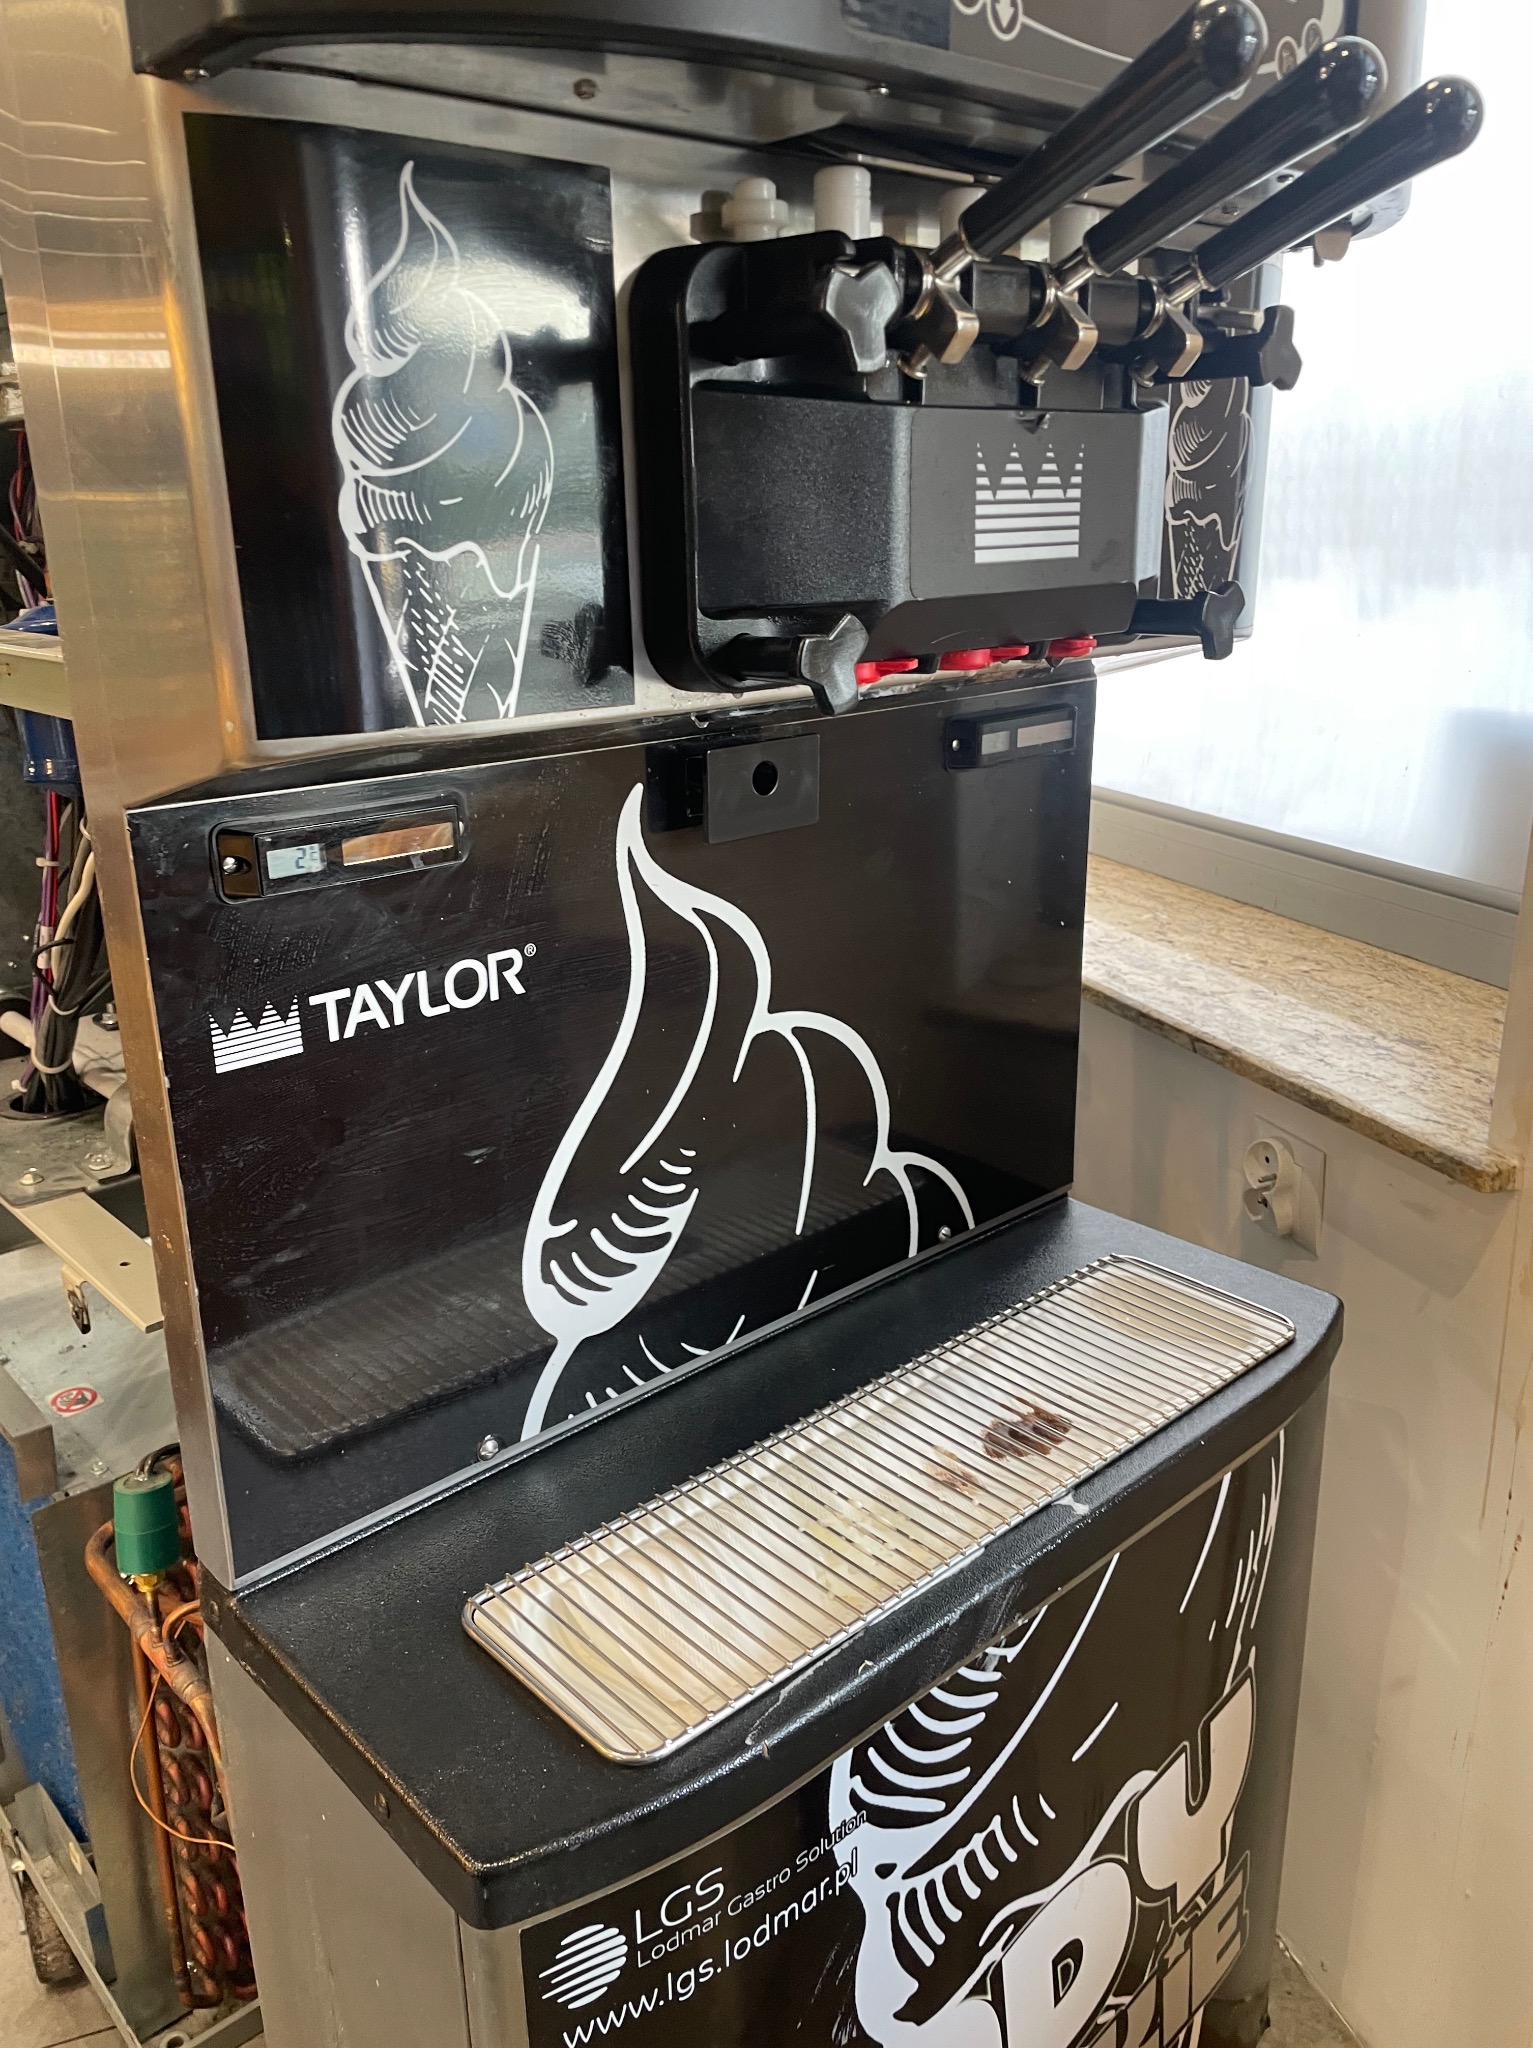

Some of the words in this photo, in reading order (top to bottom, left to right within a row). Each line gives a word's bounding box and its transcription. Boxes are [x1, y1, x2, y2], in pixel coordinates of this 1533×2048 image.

[561, 1846, 858, 2048] www.lgs.lodmar.pl
[634, 1866, 724, 1944] LGS
[637, 1910, 722, 1969] Lodmar
[726, 1865, 791, 1917] Gastro
[795, 1808, 868, 1873] Solution
